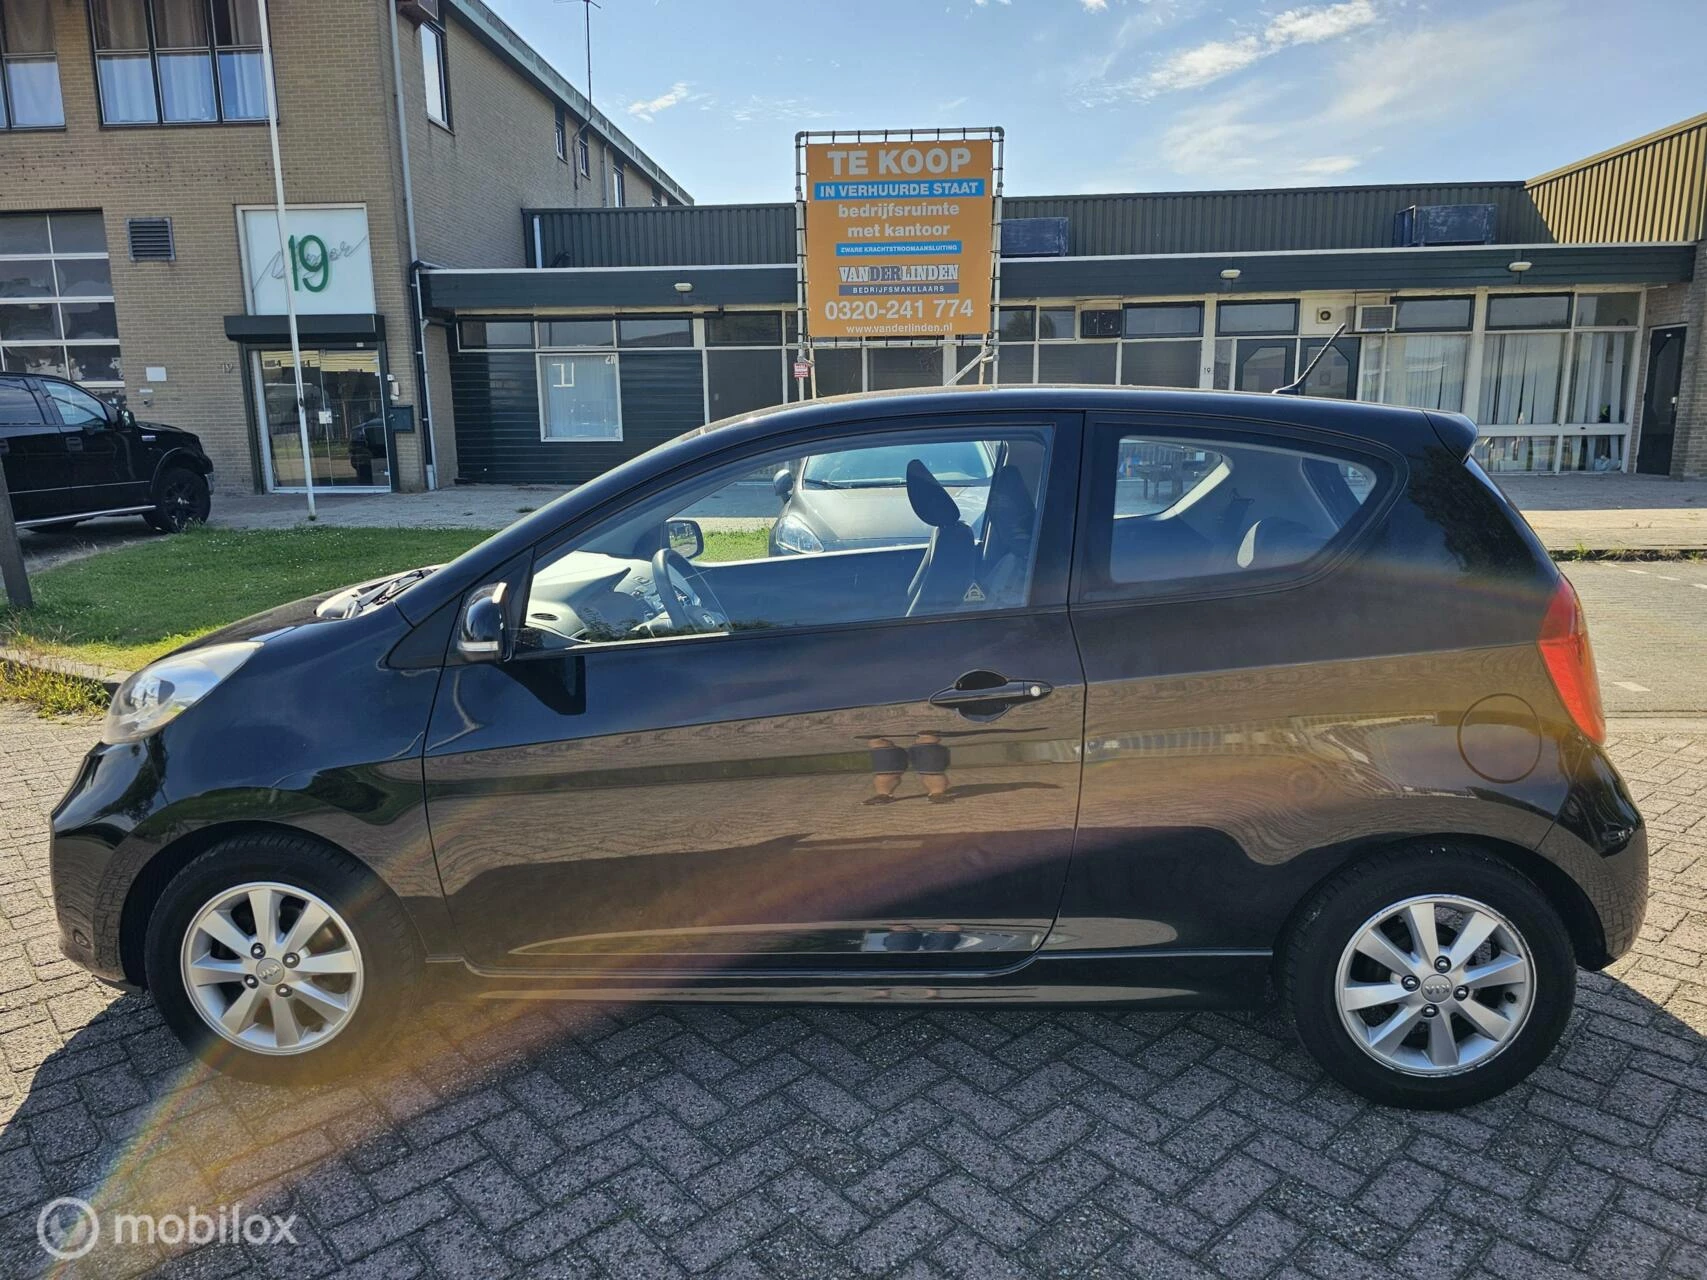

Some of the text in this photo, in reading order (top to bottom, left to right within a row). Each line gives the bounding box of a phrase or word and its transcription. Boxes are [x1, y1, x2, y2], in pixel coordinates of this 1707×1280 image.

[827, 147, 972, 176] TE KOOP
[820, 182, 978, 197] IN VERHUURDE STAAT
[838, 202, 960, 220] bedrijfsruimte
[848, 222, 951, 237] met kantoor
[288, 234, 329, 293] 19
[852, 285, 945, 294] BEDRIJFSMAKELAARS
[824, 299, 974, 321] 0320-241 774
[846, 322, 953, 334] www.vanderlinden.nl
